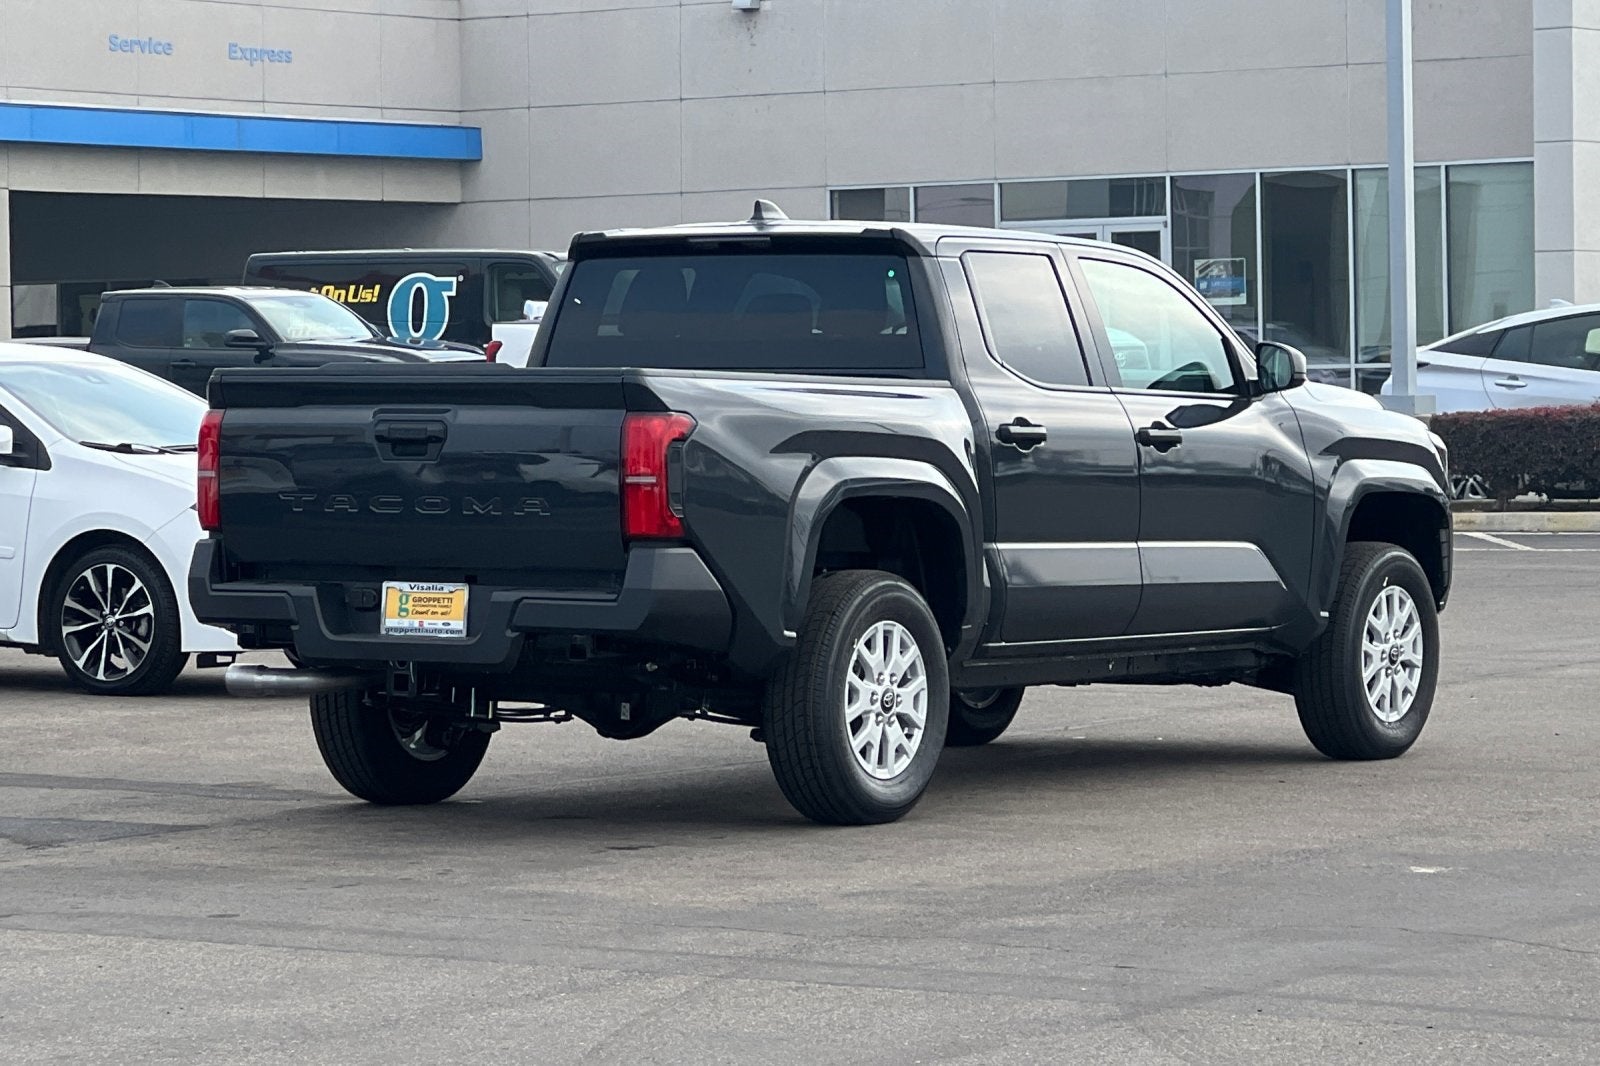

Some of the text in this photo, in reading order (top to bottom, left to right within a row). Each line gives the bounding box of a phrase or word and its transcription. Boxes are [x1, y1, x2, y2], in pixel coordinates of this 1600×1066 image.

[108, 34, 292, 66] Service Express
[321, 285, 346, 303] On
[347, 284, 381, 303] Us!
[279, 493, 551, 516] TACOMA
[409, 583, 444, 591] Visalia
[412, 596, 453, 604] GROPPETTI
[384, 626, 463, 635] groppettiauto.com
